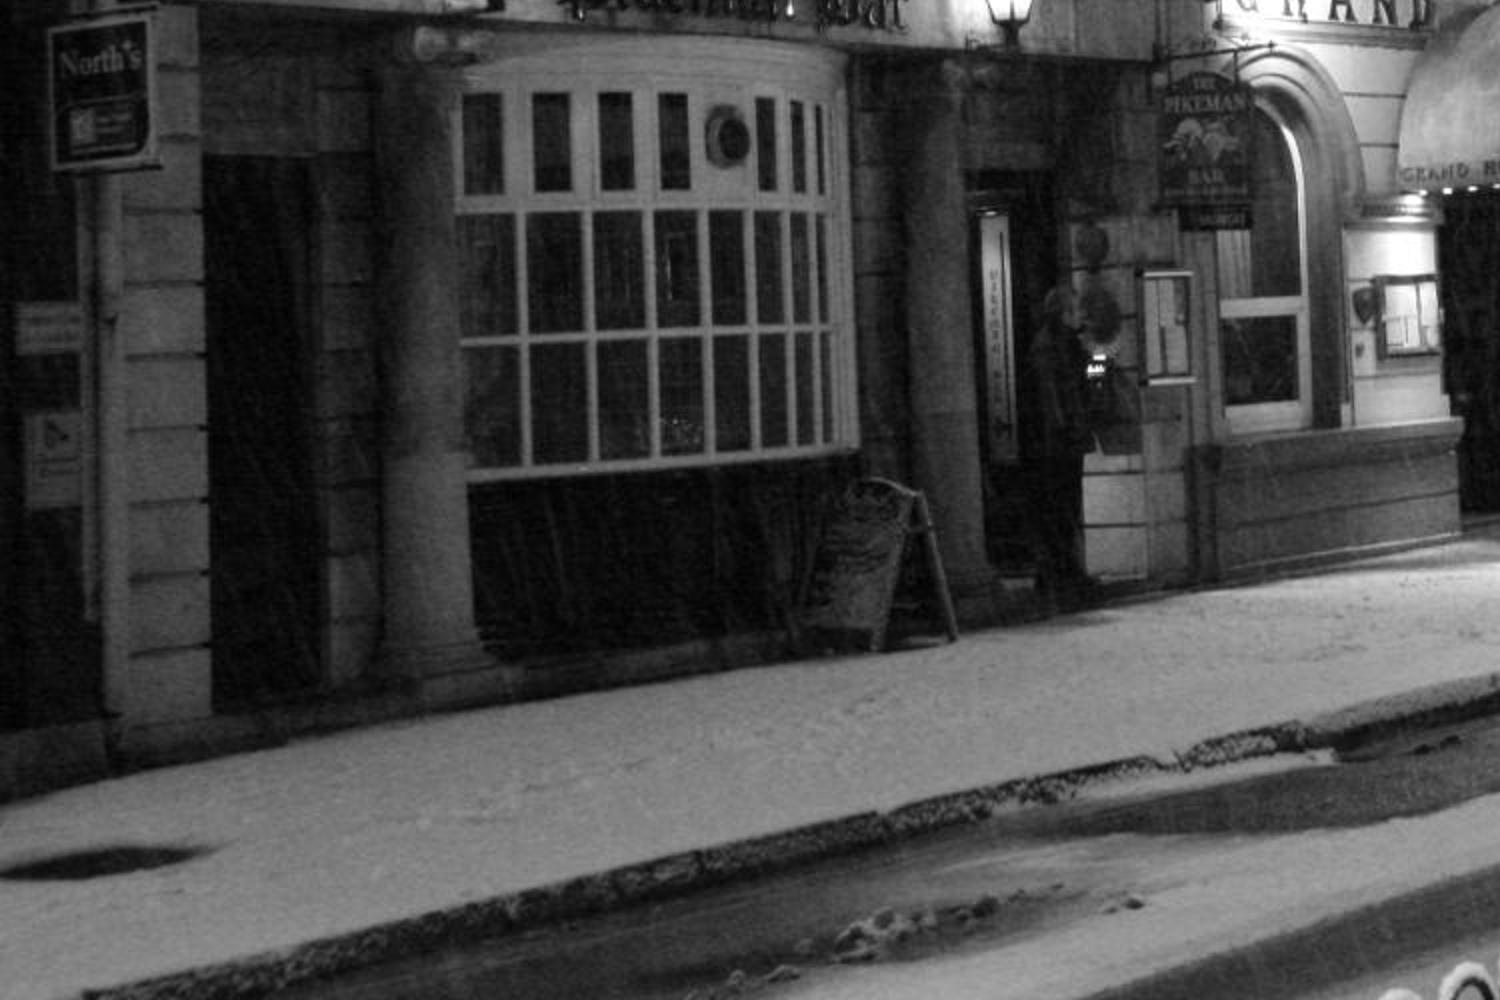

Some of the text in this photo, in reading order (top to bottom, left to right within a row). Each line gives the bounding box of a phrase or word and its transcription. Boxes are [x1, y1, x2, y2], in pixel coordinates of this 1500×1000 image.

[60, 39, 143, 80] North's
[1164, 93, 1247, 114] PIKEMAN
[1401, 162, 1470, 183] GRAND
